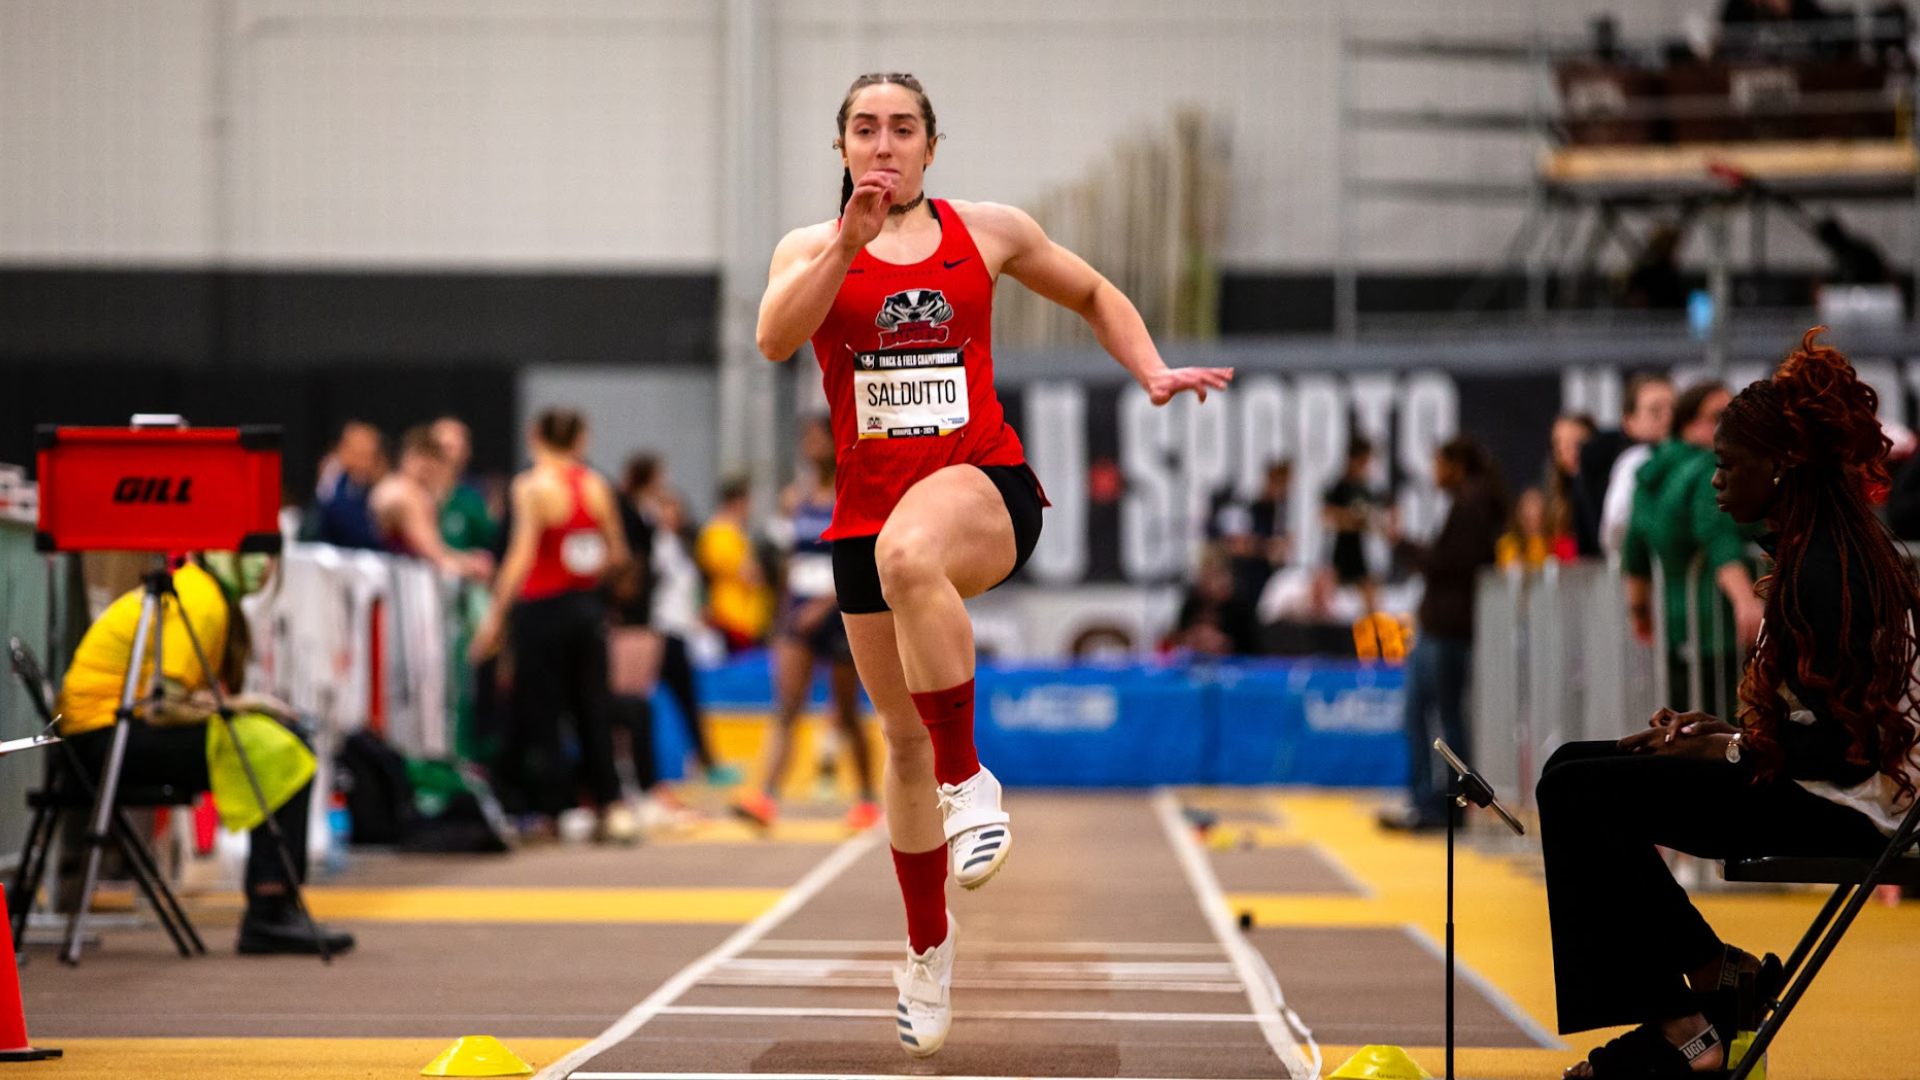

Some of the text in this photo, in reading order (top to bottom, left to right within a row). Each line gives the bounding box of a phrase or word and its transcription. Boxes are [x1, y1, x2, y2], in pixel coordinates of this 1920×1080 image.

[879, 353, 957, 367] TRACK & FIELD CHAMPIONSHIPS
[868, 379, 956, 407] SALDUTTO
[114, 476, 192, 504] GILL
[1682, 1038, 1706, 1060] UGG
